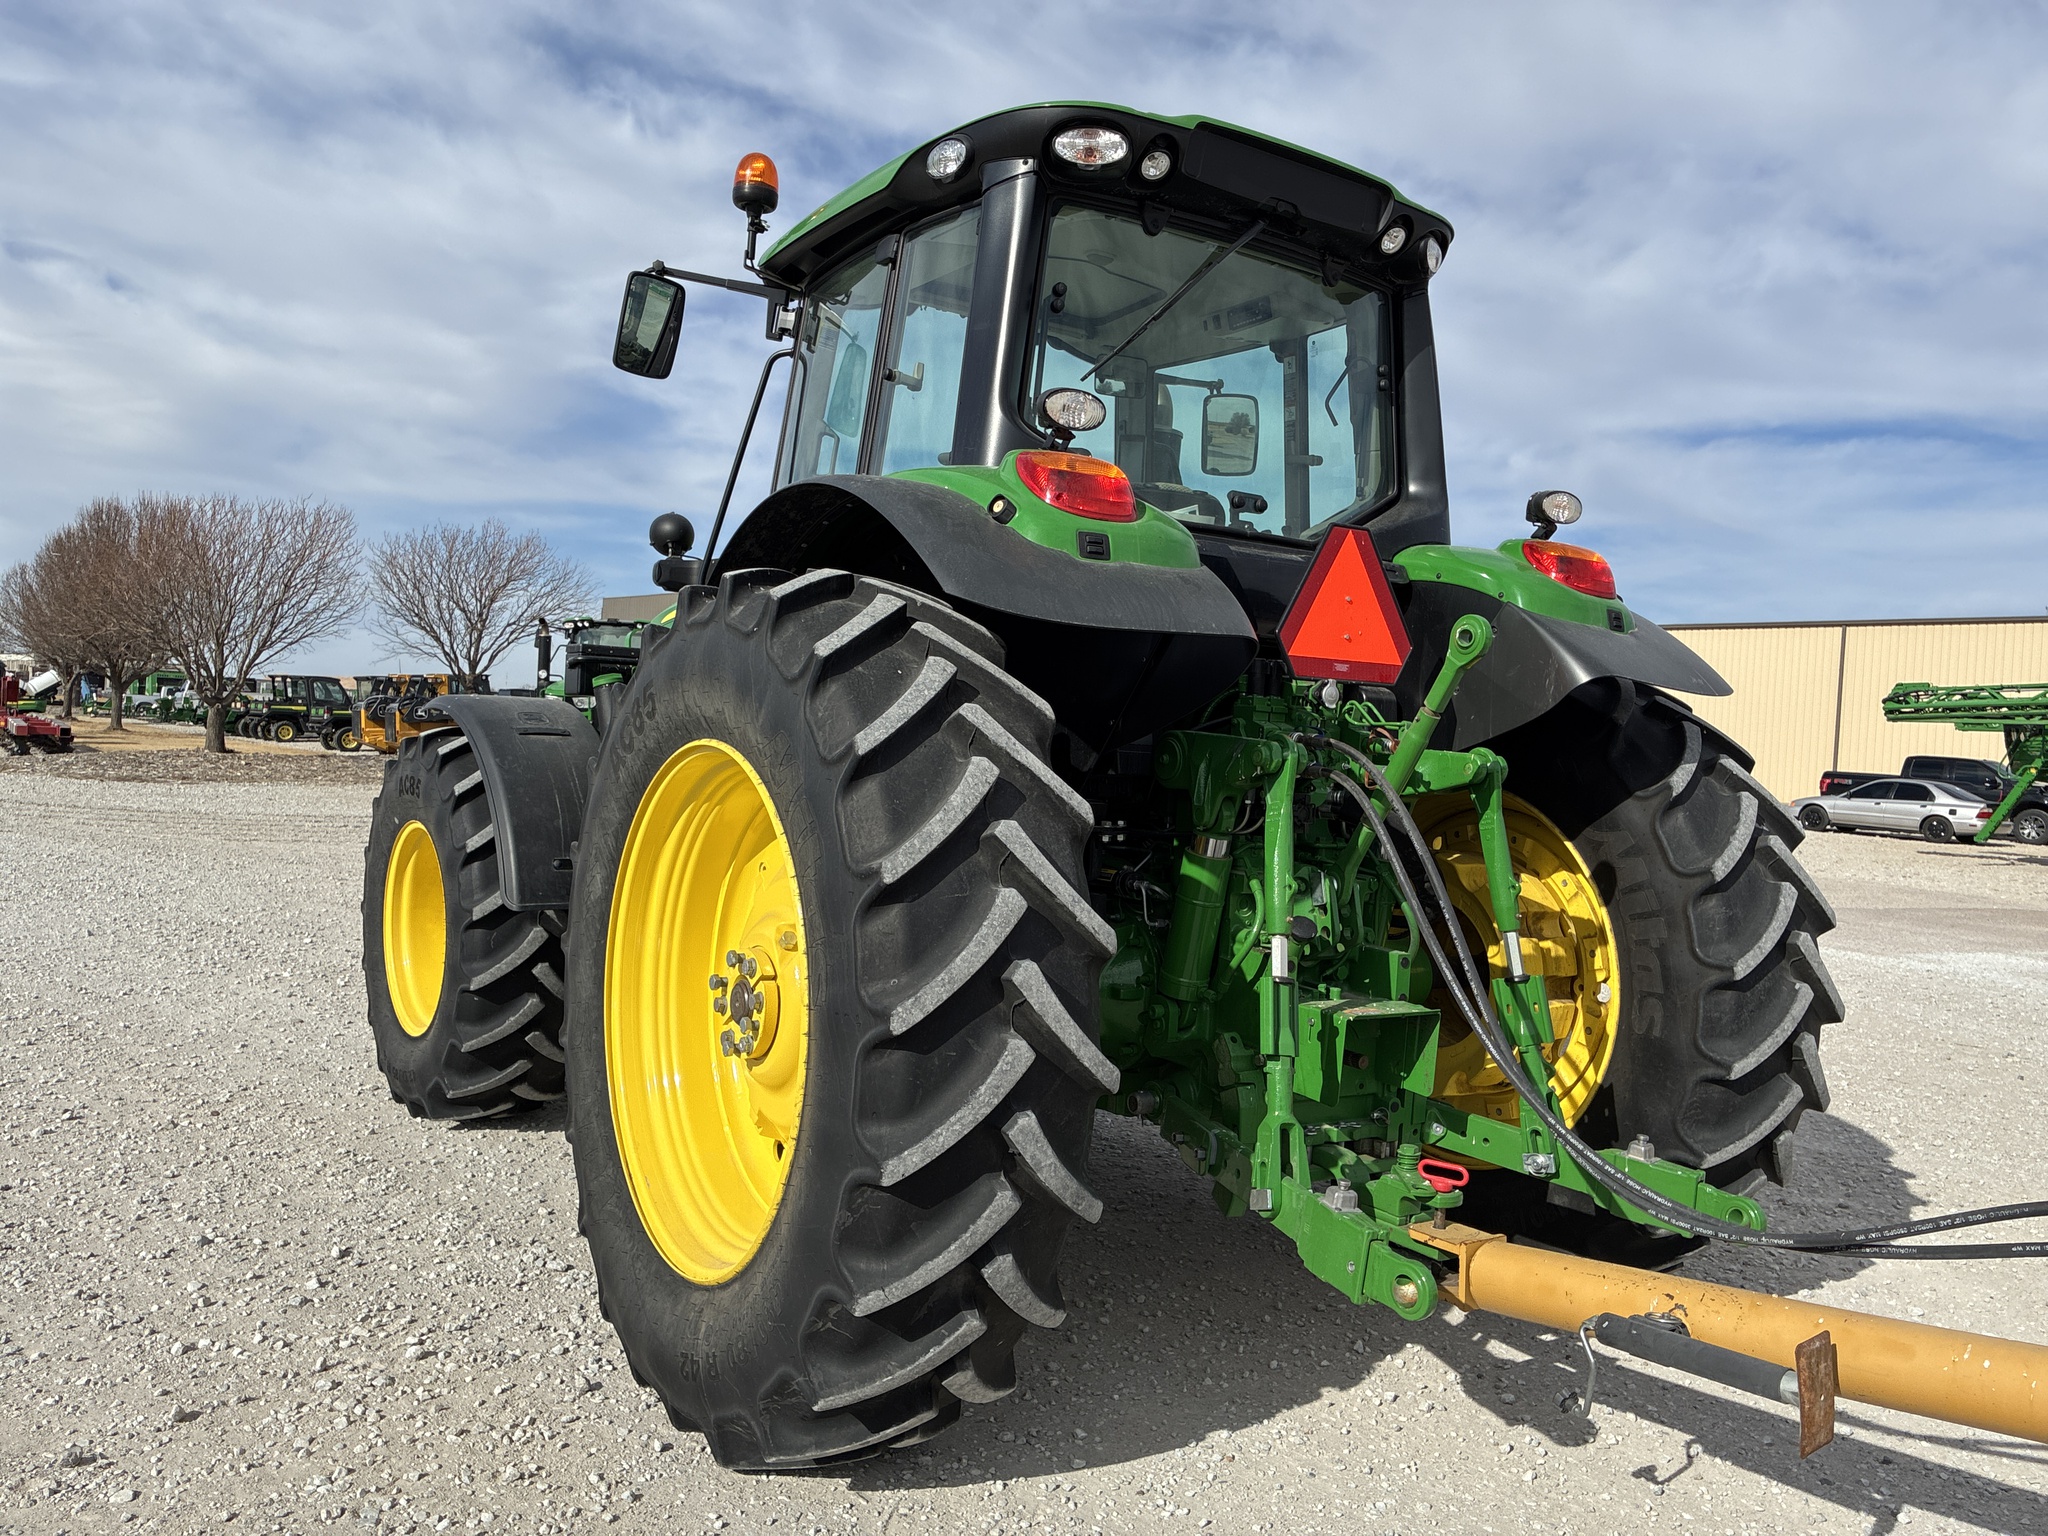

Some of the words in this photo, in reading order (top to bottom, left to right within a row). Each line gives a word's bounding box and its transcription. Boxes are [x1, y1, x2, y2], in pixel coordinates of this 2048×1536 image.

[399, 774, 422, 799] AC85
[1582, 828, 1667, 1037] Mitas
[1547, 1116, 1556, 1126] WP
[1555, 1123, 1567, 1135] MAX
[1603, 1163, 1616, 1174] SAE
[1626, 1178, 1642, 1191] HOSE
[1641, 1188, 1673, 1208] HYDRAULIC
[1647, 1209, 1657, 1217] WP
[1657, 1213, 1670, 1222] MAX
[1967, 1213, 1988, 1223] HOSE
[1938, 1219, 1952, 1228] SAE
[1717, 1230, 1729, 1239] SAE
[1867, 1232, 1882, 1240] MAX
[1743, 1236, 1759, 1244] HOSE
[1760, 1235, 1794, 1246] HYDRAULIC
[2026, 1244, 2041, 1252] MAX
[680, 1350, 700, 1383] 42
